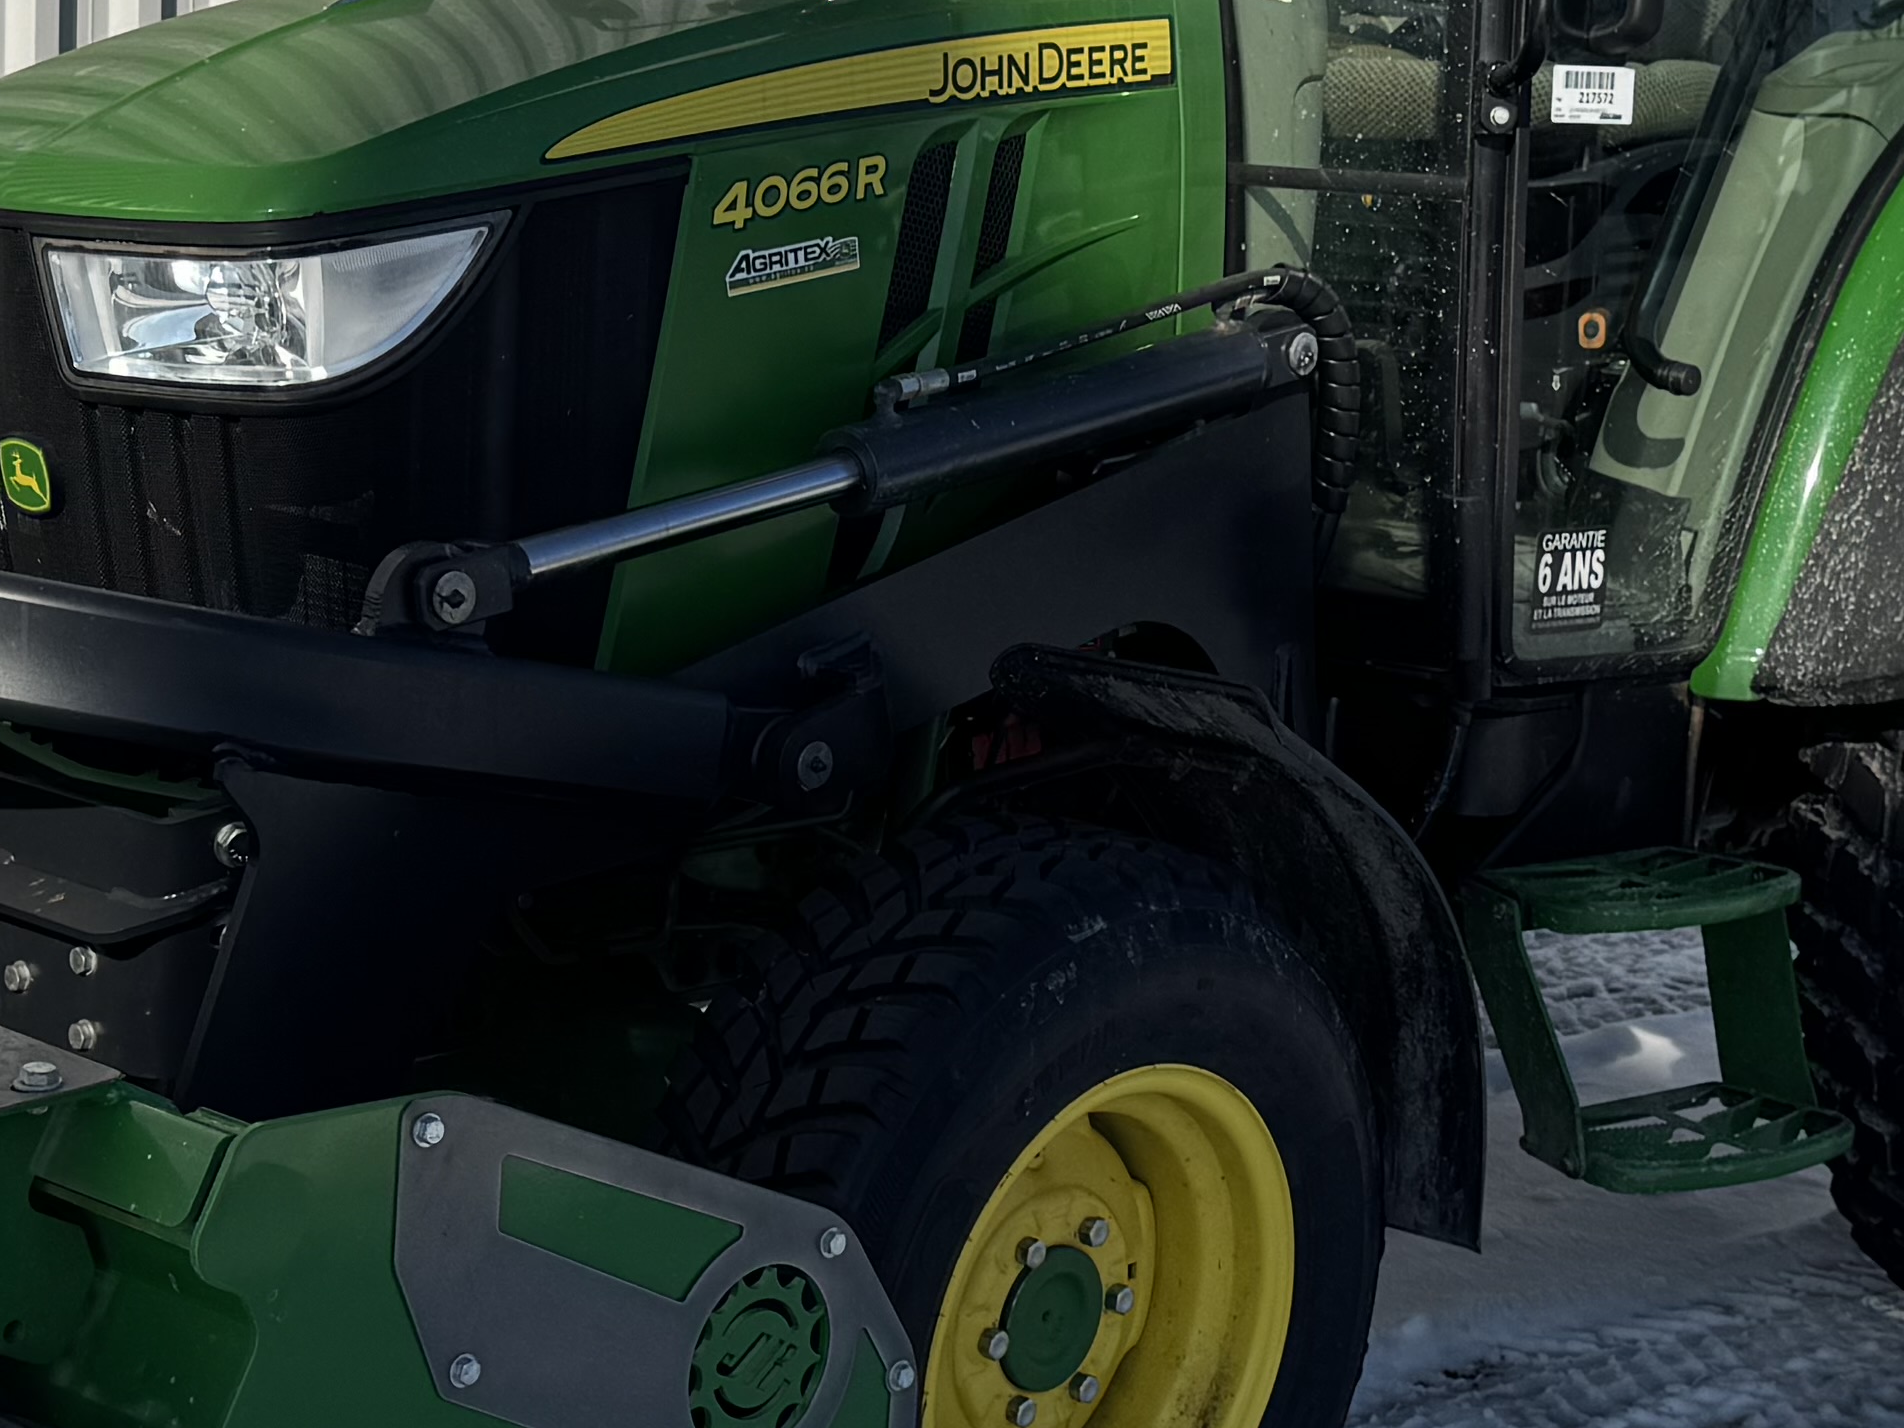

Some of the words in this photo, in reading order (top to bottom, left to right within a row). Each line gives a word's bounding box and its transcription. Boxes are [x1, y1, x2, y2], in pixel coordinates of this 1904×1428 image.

[928, 52, 1030, 98] JOHN
[1038, 42, 1149, 86] DEERE
[1578, 91, 1615, 105] 217572
[712, 154, 887, 230] 4066R
[729, 239, 832, 279] AGRITEX
[1542, 529, 1607, 552] GARANTIE
[1537, 552, 1553, 594] 6
[1556, 548, 1606, 592] ANS
